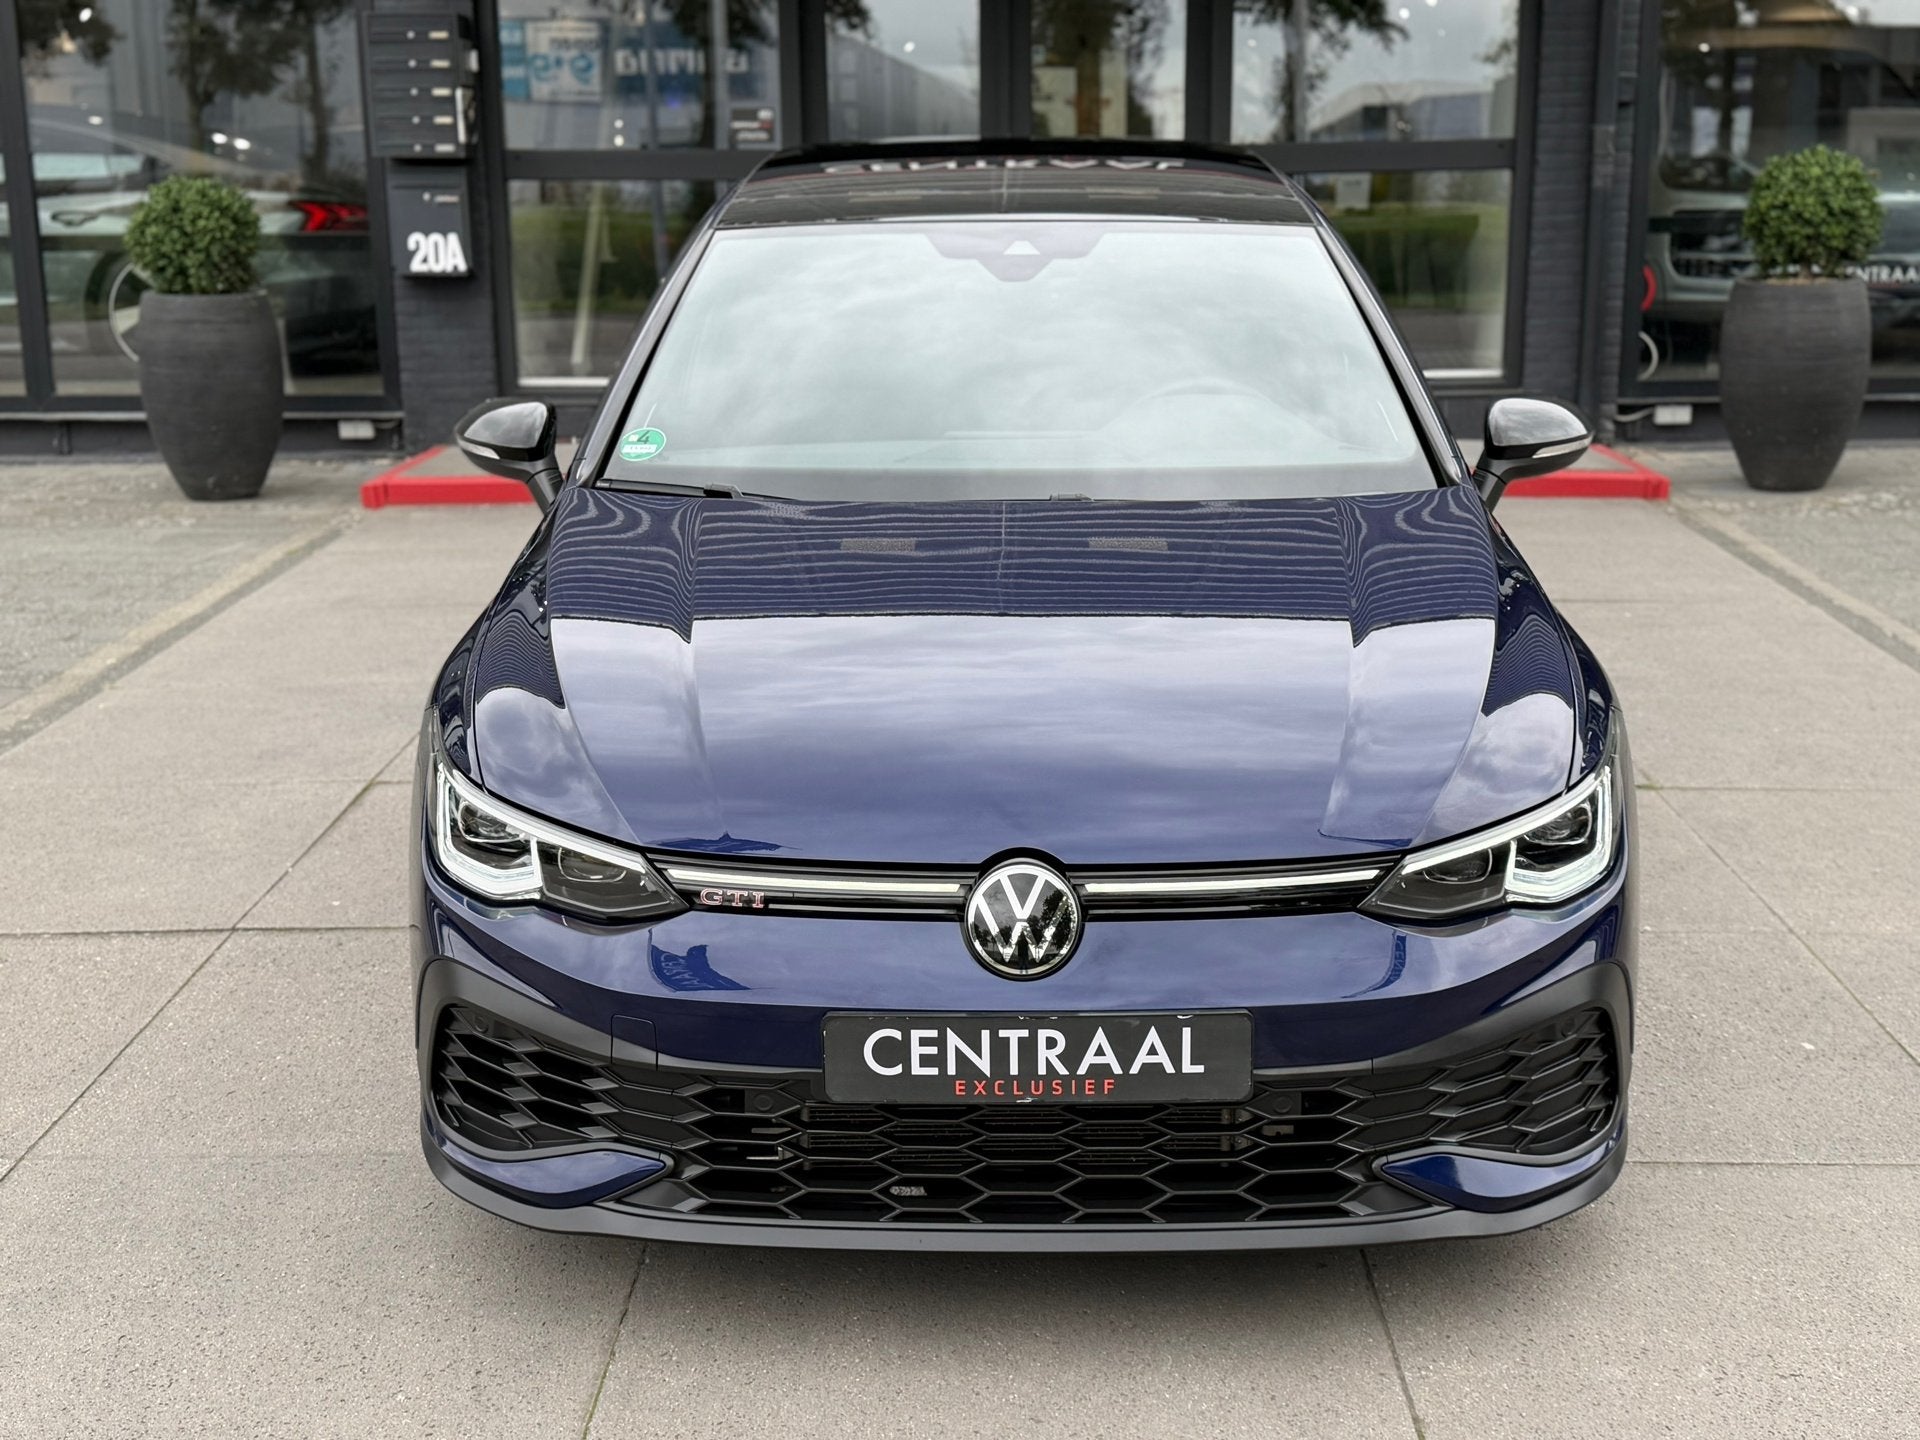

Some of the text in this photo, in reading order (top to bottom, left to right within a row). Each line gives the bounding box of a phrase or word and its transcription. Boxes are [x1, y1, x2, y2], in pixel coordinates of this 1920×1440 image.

[407, 231, 468, 273] 20A
[700, 887, 765, 909] GTI
[862, 1025, 1205, 1077] CENTRAAL
[954, 1078, 1117, 1096] EXCLUSIEF
